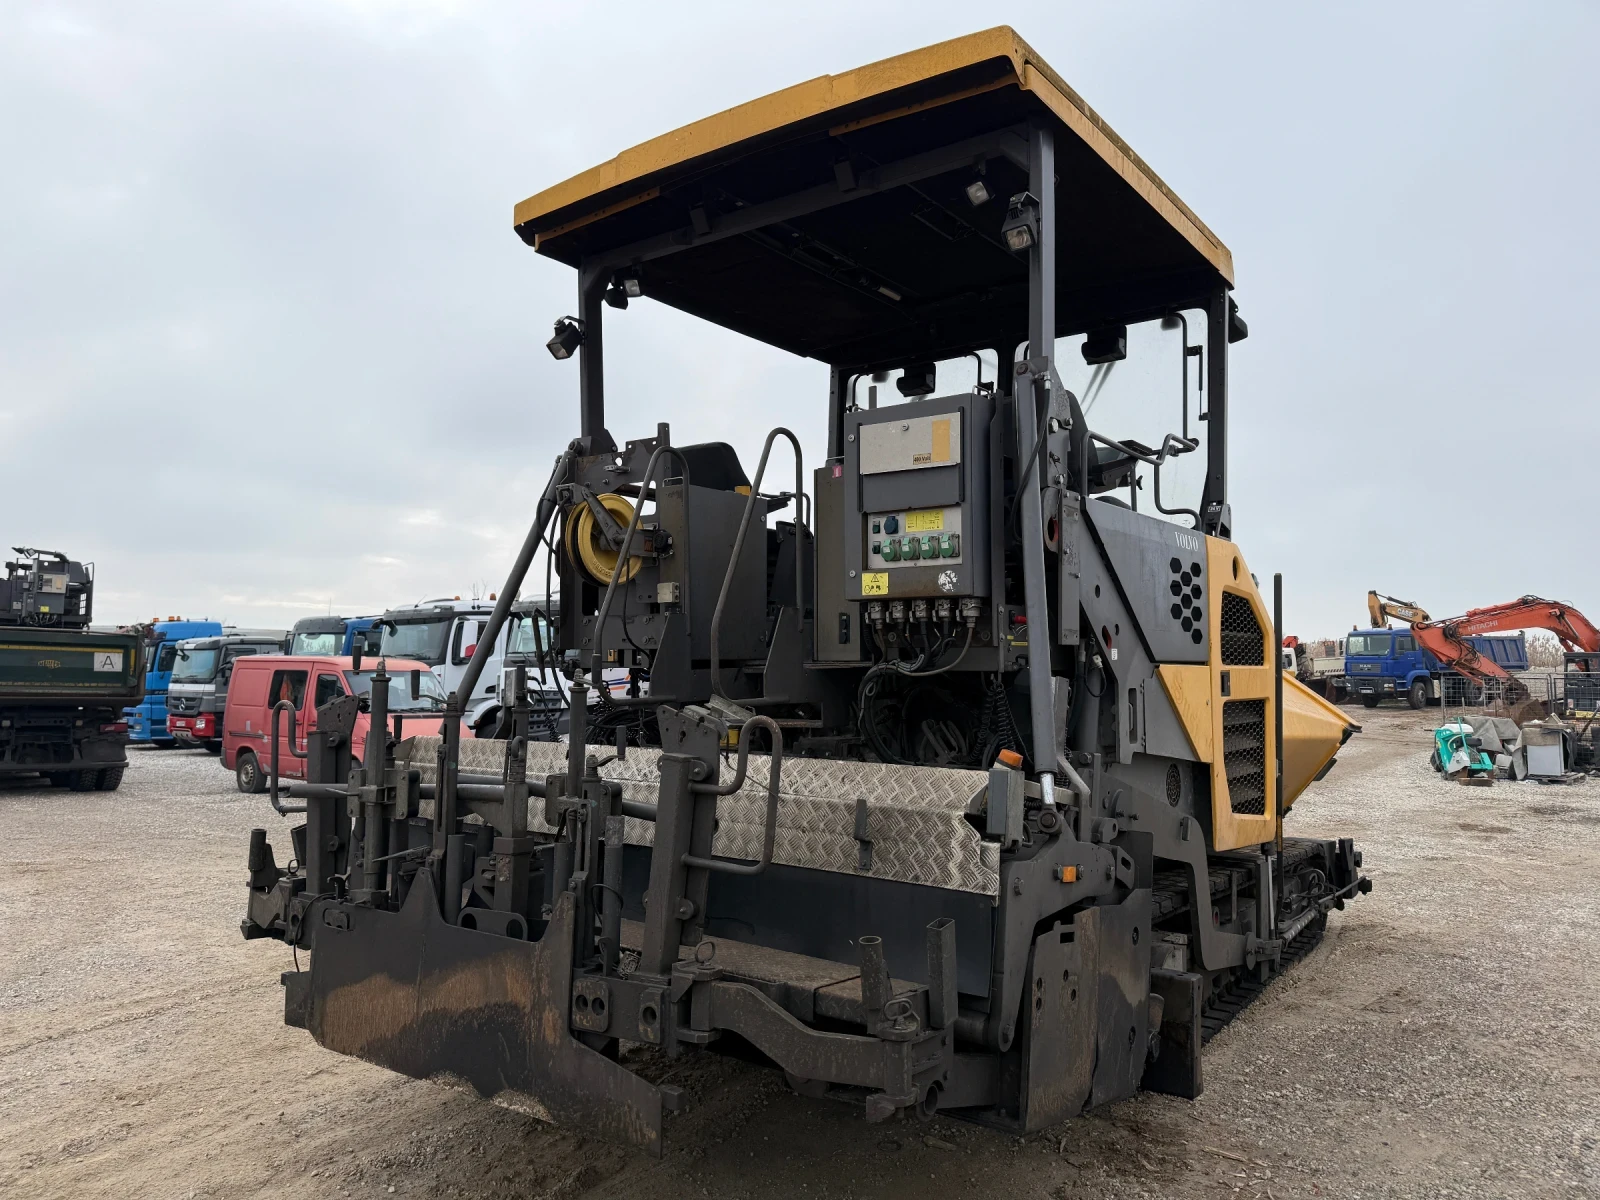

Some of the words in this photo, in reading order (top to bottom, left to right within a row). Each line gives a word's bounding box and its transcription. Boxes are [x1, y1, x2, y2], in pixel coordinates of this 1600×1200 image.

[1175, 531, 1199, 551] VOLVO
[1397, 608, 1414, 618] CASE
[1467, 620, 1498, 632] HITACHI
[102, 655, 115, 669] A
